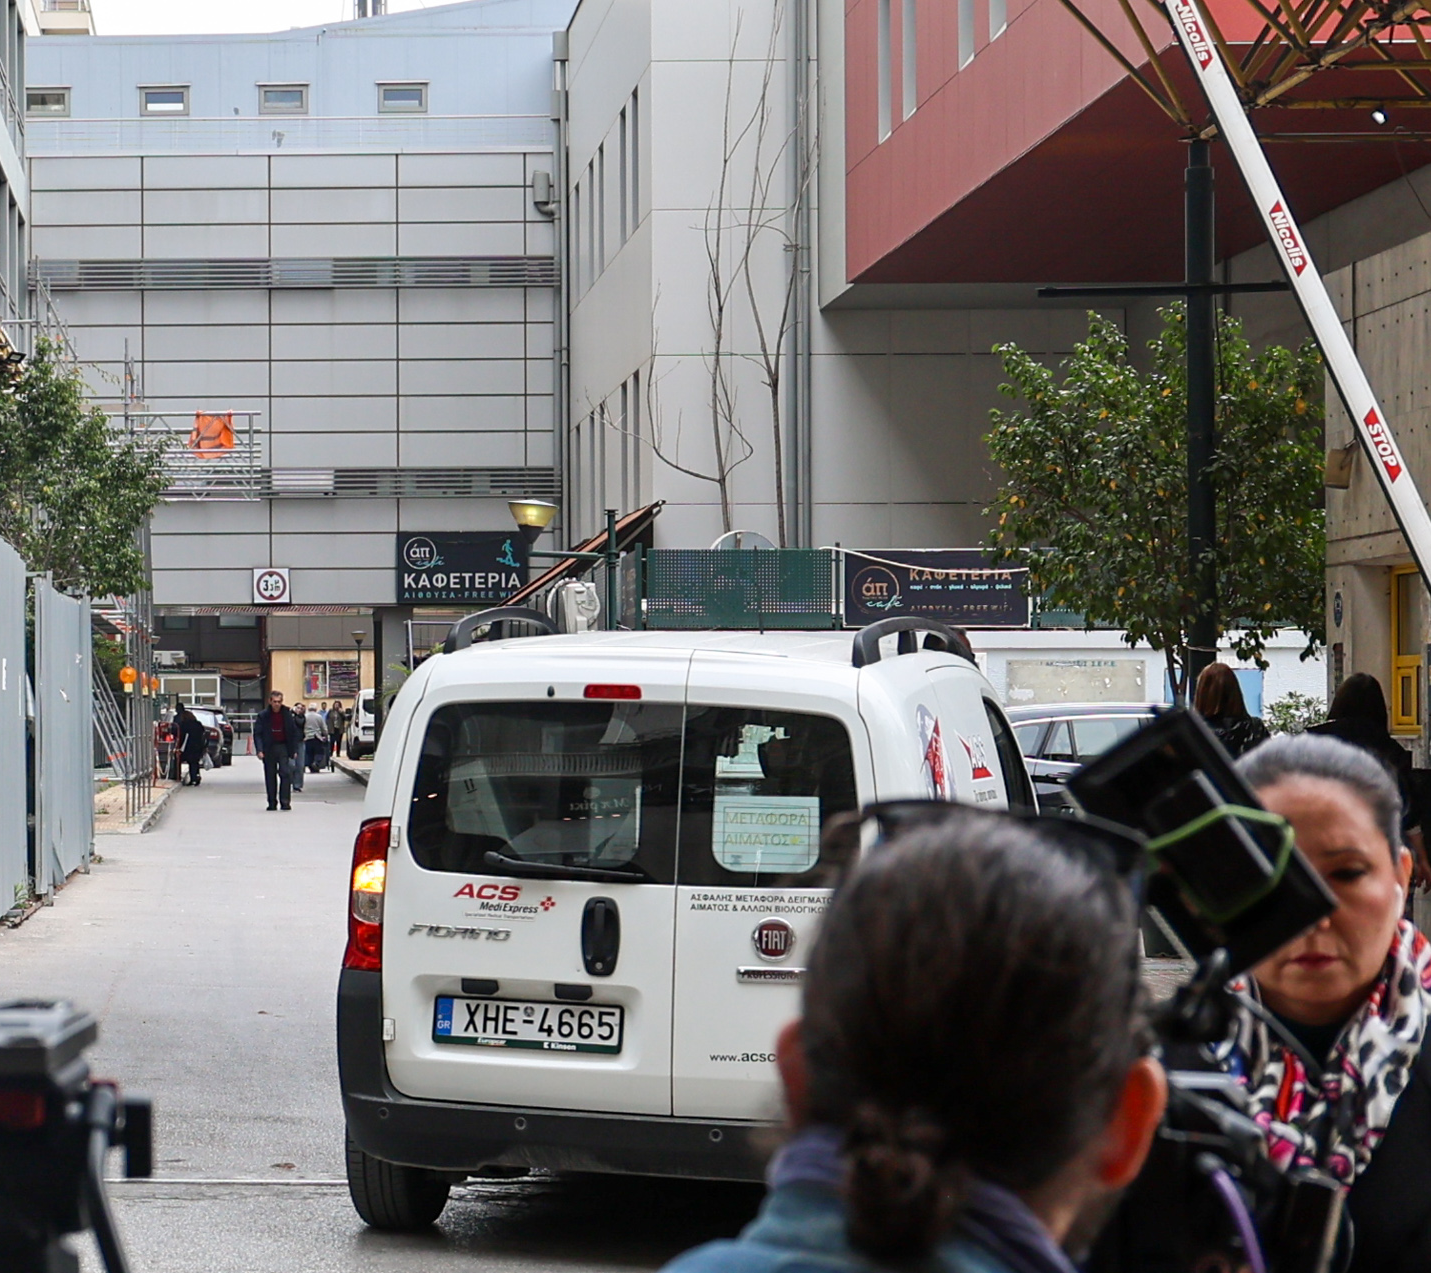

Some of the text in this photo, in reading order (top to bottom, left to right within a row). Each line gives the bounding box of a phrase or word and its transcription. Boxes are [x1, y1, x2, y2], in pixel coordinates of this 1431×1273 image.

[1176, 4, 1209, 62] Nicolis
[1270, 211, 1304, 267] Nicolis
[1368, 422, 1398, 469] STOP
[404, 572, 521, 588] ΚΑΦΕΤΕΡΙΑ
[909, 568, 1012, 581] ΚΑΦΕΤΕΡΙΑ
[862, 577, 888, 597] άπ
[725, 812, 808, 826] ΜΕΤΑΦΟΡΑ
[724, 834, 790, 847] ΑΙΜΑΤΟΣ
[453, 883, 523, 901] ACS
[690, 894, 734, 902] ΑΣΦΑΛΗΣ
[735, 894, 786, 903] ΜΕΤΑΦΟΡΑ
[690, 903, 731, 912] ΑΙΜΑΤΟΣ
[732, 904, 738, 912] &
[740, 904, 773, 913] ΑΛΛΩΝ
[761, 930, 787, 950] FIAT
[437, 1020, 450, 1029] GR
[463, 1002, 617, 1041] XHE-4665
[709, 1052, 777, 1063] www.acsc
